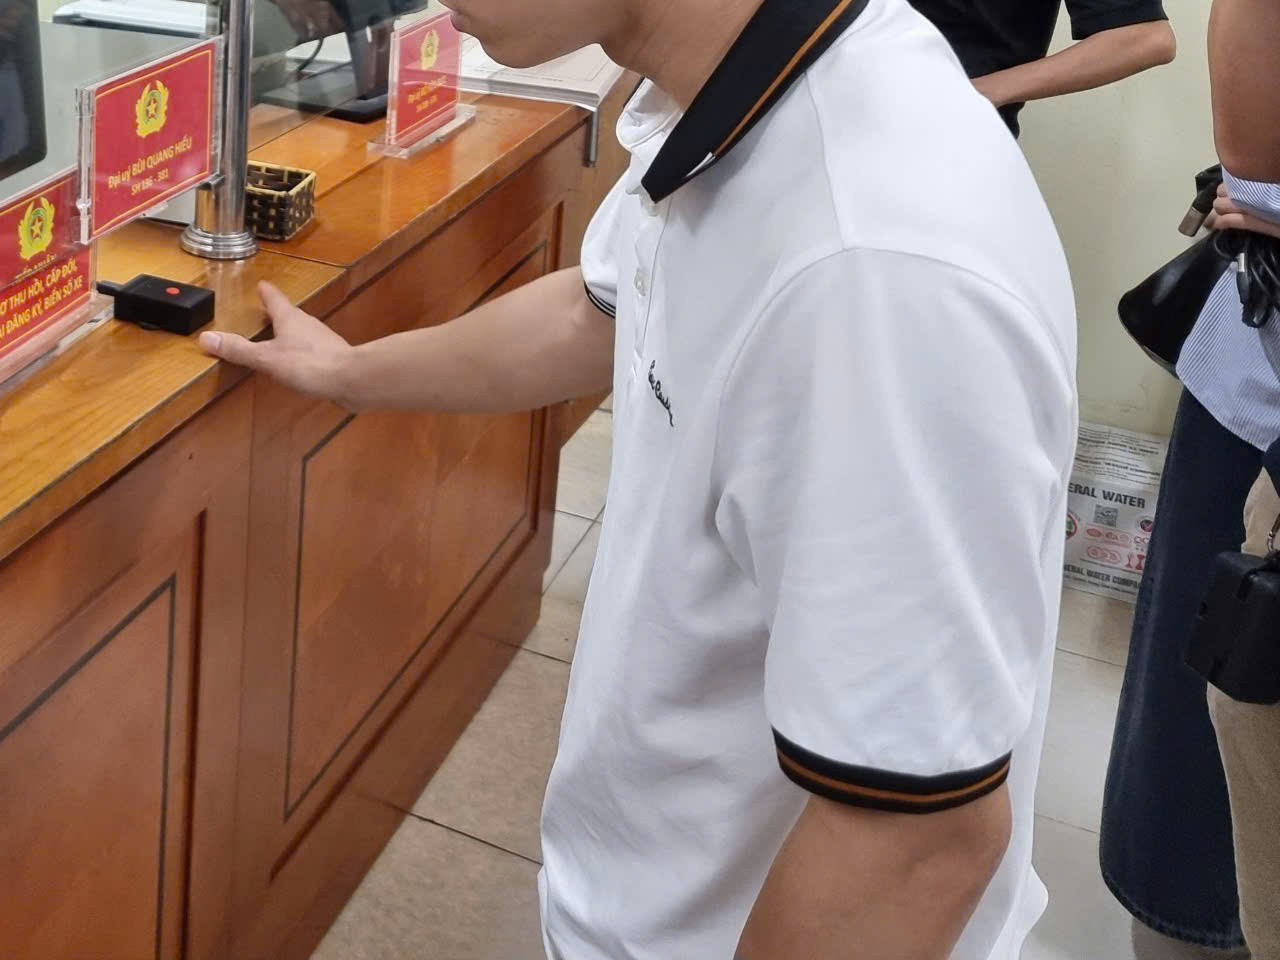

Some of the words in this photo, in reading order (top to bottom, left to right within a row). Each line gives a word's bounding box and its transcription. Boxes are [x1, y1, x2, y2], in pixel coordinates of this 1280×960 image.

[146, 145, 174, 169] QUANG
[9, 288, 27, 310] THU
[6, 308, 31, 334] ĐĂNG
[1068, 482, 1097, 498] ERAL
[1102, 489, 1146, 509] WATER
